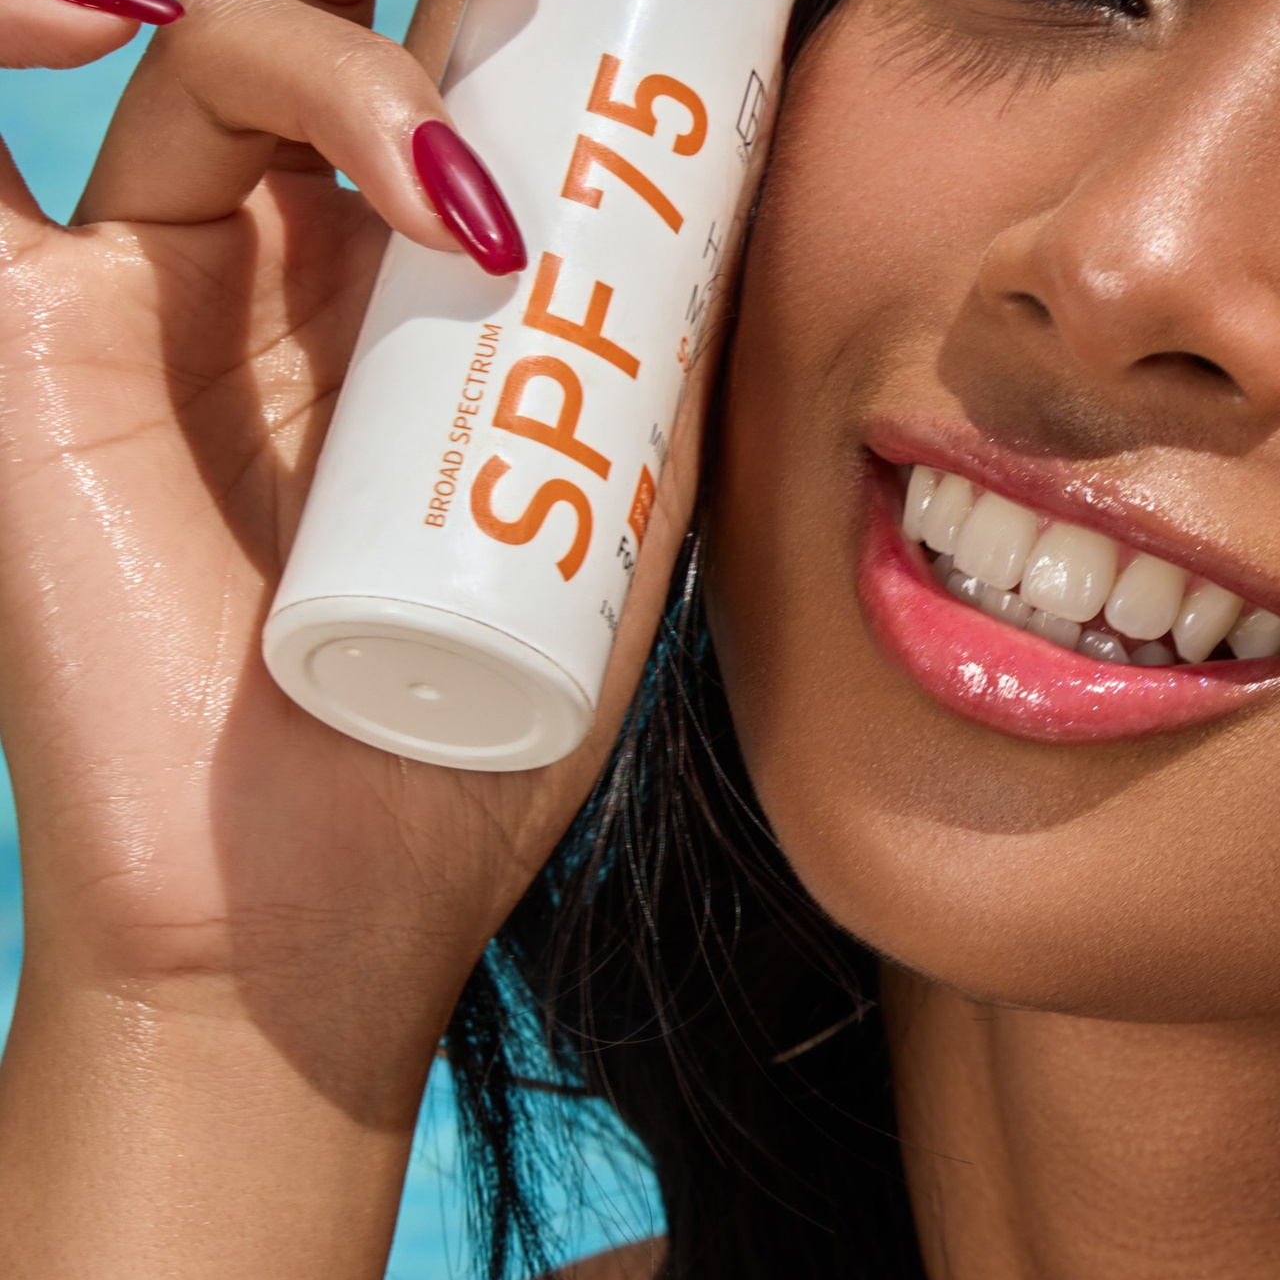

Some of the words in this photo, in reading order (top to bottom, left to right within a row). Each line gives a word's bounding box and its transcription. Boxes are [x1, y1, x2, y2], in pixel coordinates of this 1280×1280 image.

[423, 450, 465, 529] BROAD
[448, 323, 503, 445] SPECTRUM
[470, 251, 640, 582] SPF
[560, 52, 709, 235] 75
